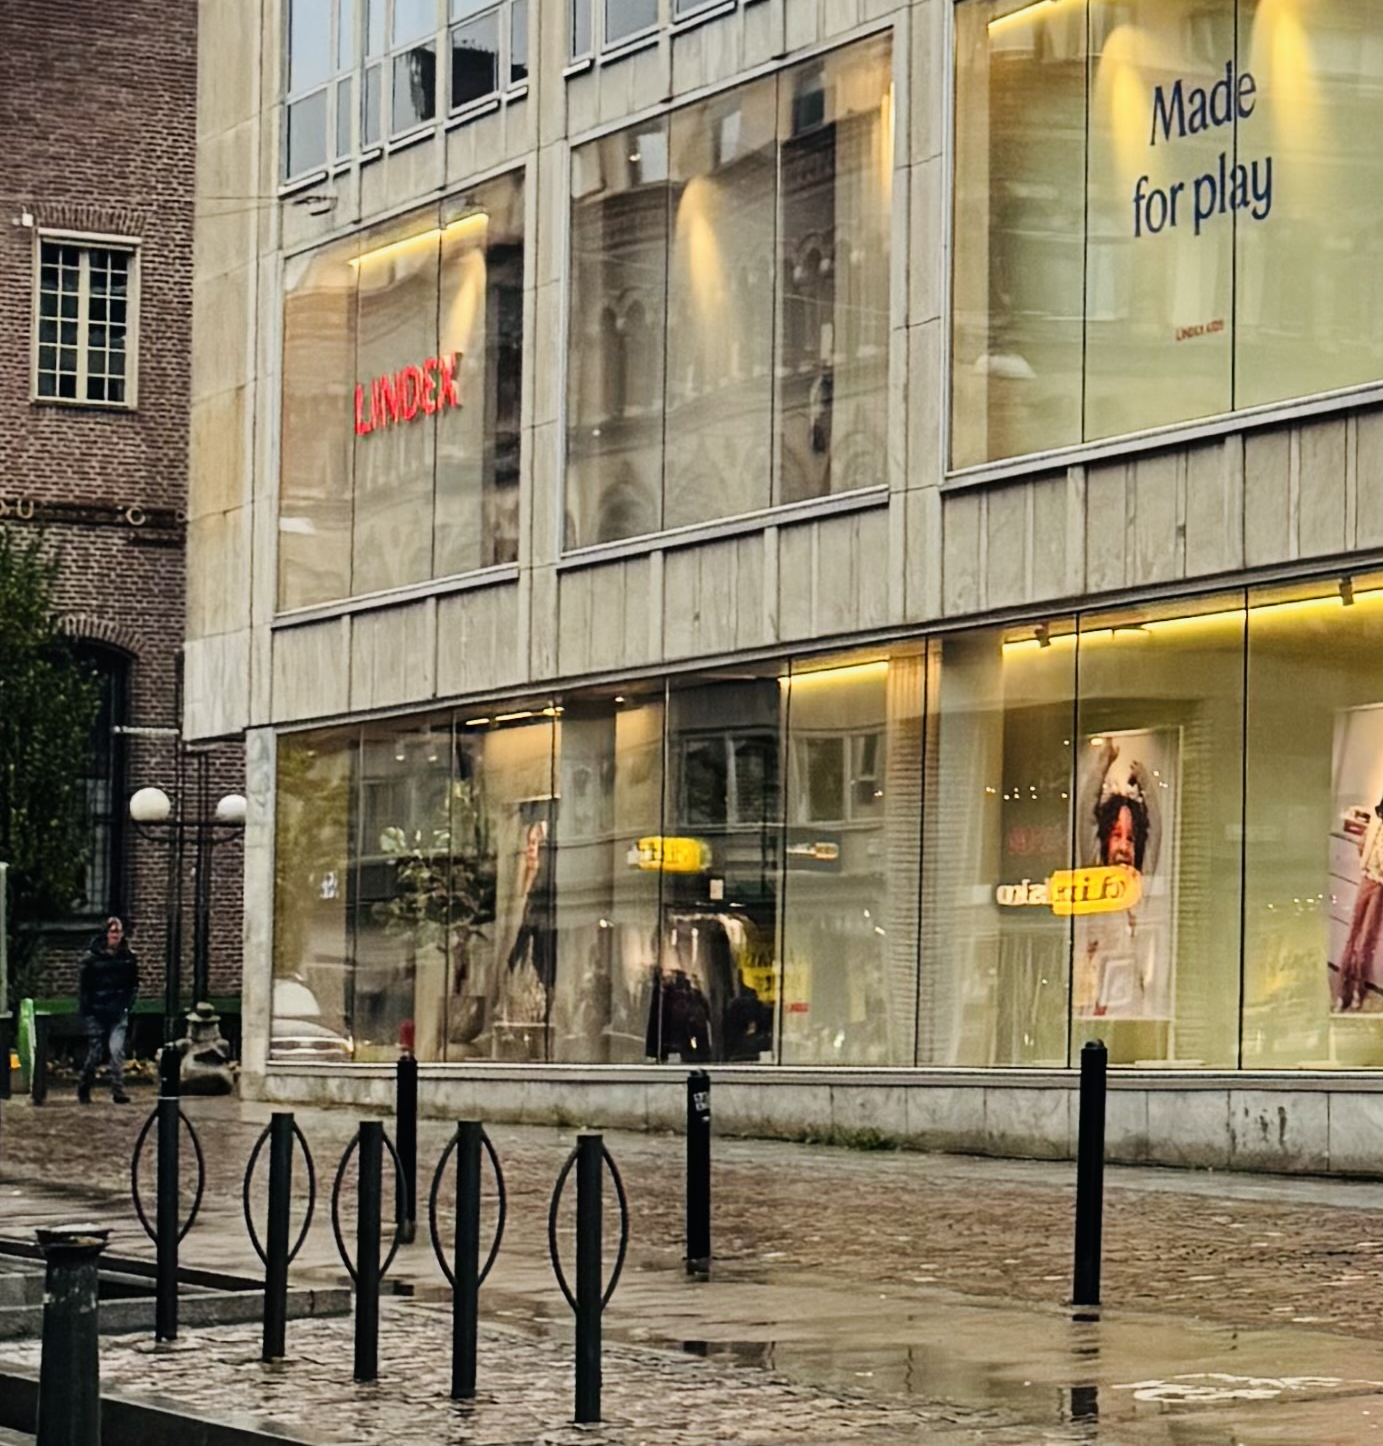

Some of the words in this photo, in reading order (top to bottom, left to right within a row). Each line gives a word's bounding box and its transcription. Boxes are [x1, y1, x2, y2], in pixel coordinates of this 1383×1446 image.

[1150, 60, 1256, 146] Made
[1133, 175, 1185, 238] for
[1194, 151, 1272, 236] play
[354, 353, 460, 436] LINDEX
